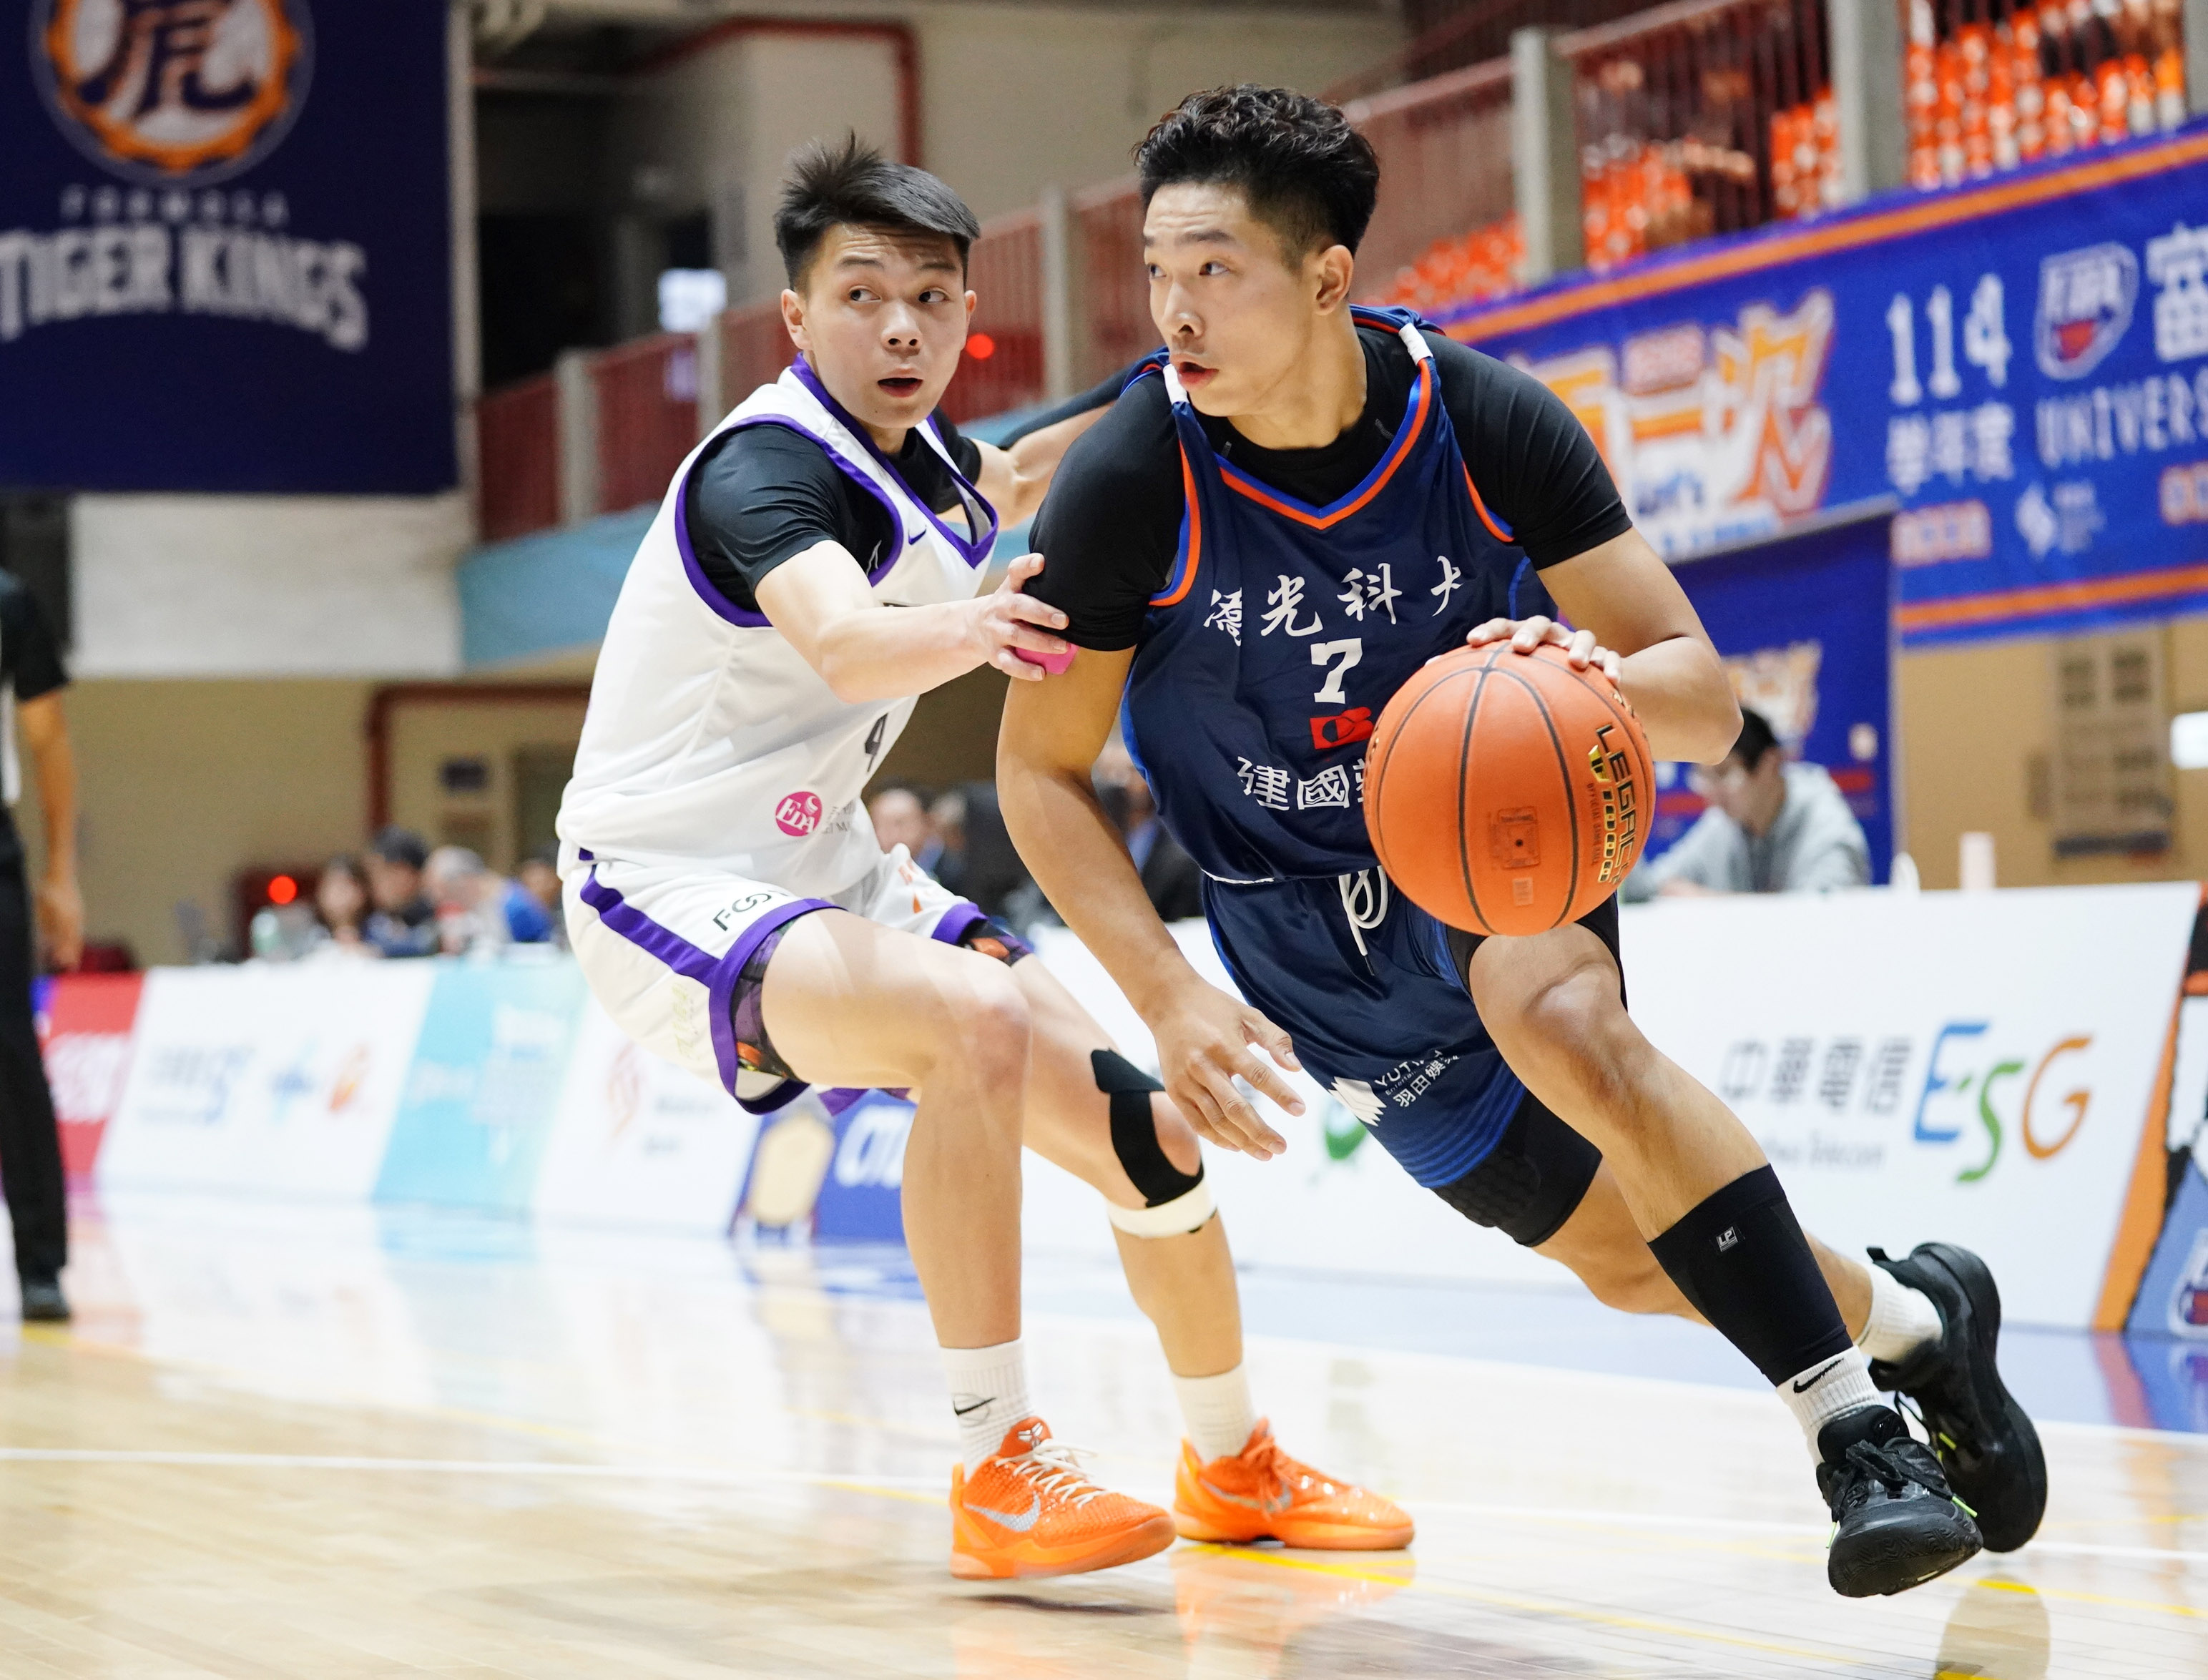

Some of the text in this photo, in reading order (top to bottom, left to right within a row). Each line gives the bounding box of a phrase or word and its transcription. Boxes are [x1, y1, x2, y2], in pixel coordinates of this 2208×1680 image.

[182, 226, 368, 352] KINGS
[1886, 275, 2012, 407] 114
[1310, 637, 1363, 704] 7
[864, 712, 888, 773] 4
[1237, 755, 1366, 812] 建國
[1718, 1229, 1732, 1246] LP
